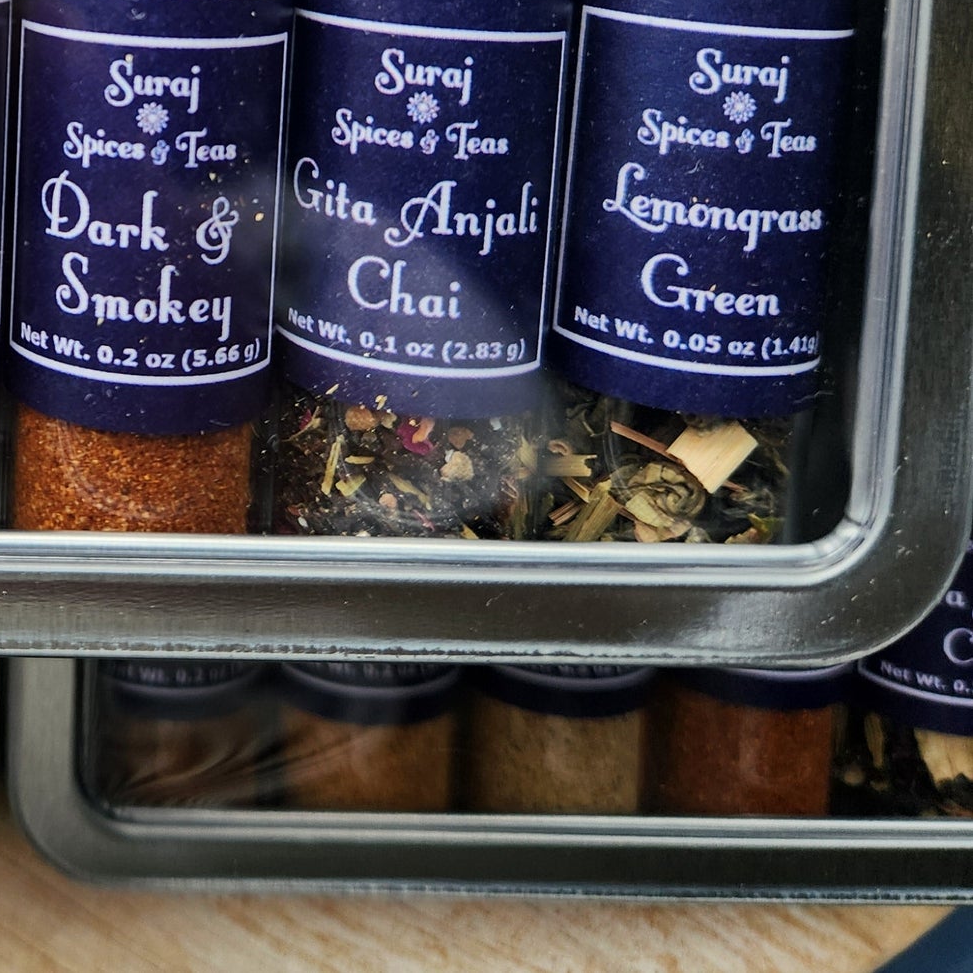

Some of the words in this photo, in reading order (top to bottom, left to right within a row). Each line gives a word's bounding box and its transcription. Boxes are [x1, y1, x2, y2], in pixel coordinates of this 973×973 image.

[104, 58, 201, 114] Suraj
[374, 47, 474, 107] Suraj
[689, 47, 790, 104] Suraj
[63, 121, 145, 168] Spices
[150, 139, 170, 165] &
[175, 127, 237, 168] Teas
[331, 107, 414, 155] Spices
[419, 129, 440, 155] &
[445, 120, 509, 161] Teas
[636, 107, 729, 155] Spices
[735, 128, 755, 154] &
[760, 117, 817, 159] Teas
[41, 169, 170, 252] Dark
[196, 195, 240, 266] &
[293, 157, 376, 226] Gita
[384, 180, 539, 256] Anjali
[602, 162, 822, 252] Lemongrass
[55, 252, 232, 342] Smokey
[347, 255, 461, 320] Chai
[641, 252, 780, 317] Green
[21, 322, 49, 350] Net
[53, 335, 90, 361] Wt.
[97, 345, 138, 367] 0.2
[145, 350, 176, 369] oz
[182, 346, 240, 372] (5.66
[244, 338, 260, 363] g)
[287, 307, 314, 333] Net
[318, 324, 352, 346] Wt.
[359, 330, 396, 354] 0.1
[404, 340, 435, 359] oz
[441, 339, 502, 364] (2.83
[506, 338, 526, 362] g)
[574, 305, 609, 333] Net
[614, 318, 654, 345] Wt.
[662, 330, 722, 355] 0.05
[728, 340, 755, 357] oz
[953, 679, 973, 693] 0.
